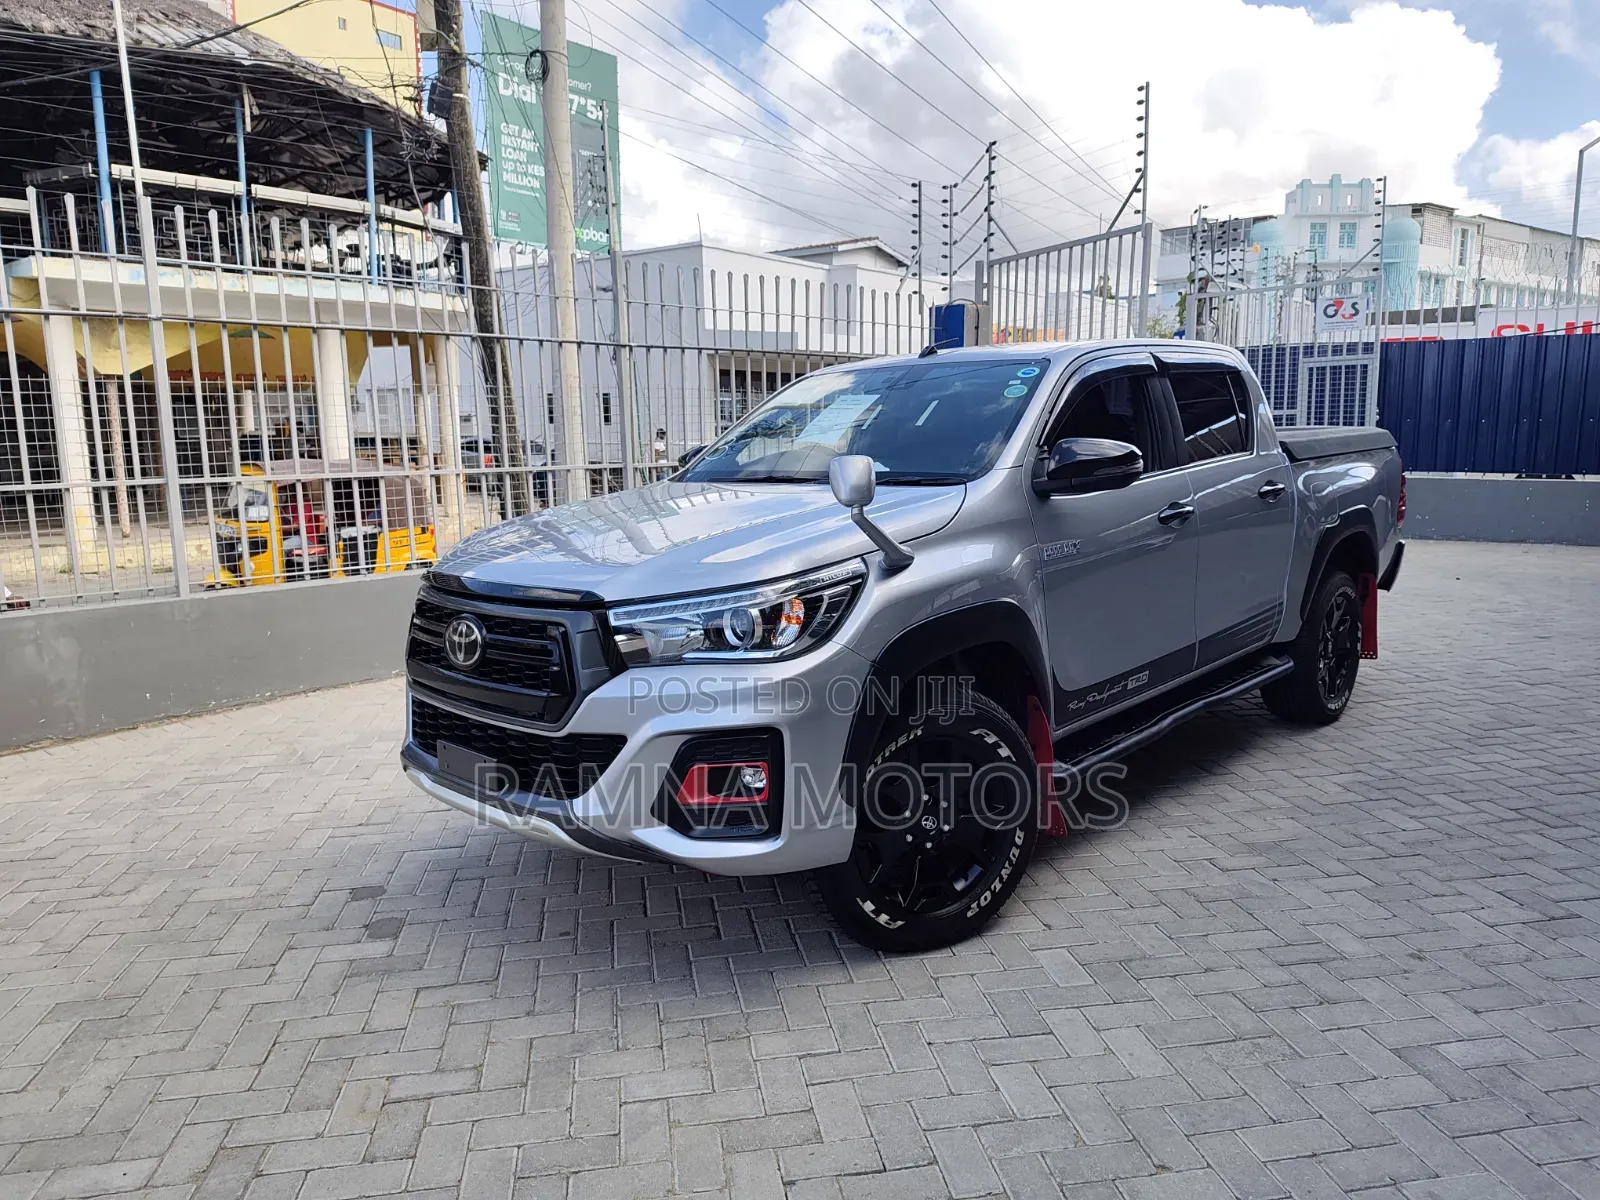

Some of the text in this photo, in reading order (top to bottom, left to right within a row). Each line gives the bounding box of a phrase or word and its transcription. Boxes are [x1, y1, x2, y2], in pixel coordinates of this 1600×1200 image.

[498, 72, 537, 104] Dial
[568, 79, 592, 92] omer?
[500, 122, 535, 140] GET AN
[501, 134, 539, 153] INSTANT
[501, 146, 527, 162] LOAN
[502, 160, 545, 177] up to KES
[503, 171, 540, 189] MILLION
[1323, 299, 1360, 320] G4S
[1128, 671, 1149, 689] TRD
[969, 728, 1017, 762] AT
[966, 826, 1026, 918] DUNLOP
